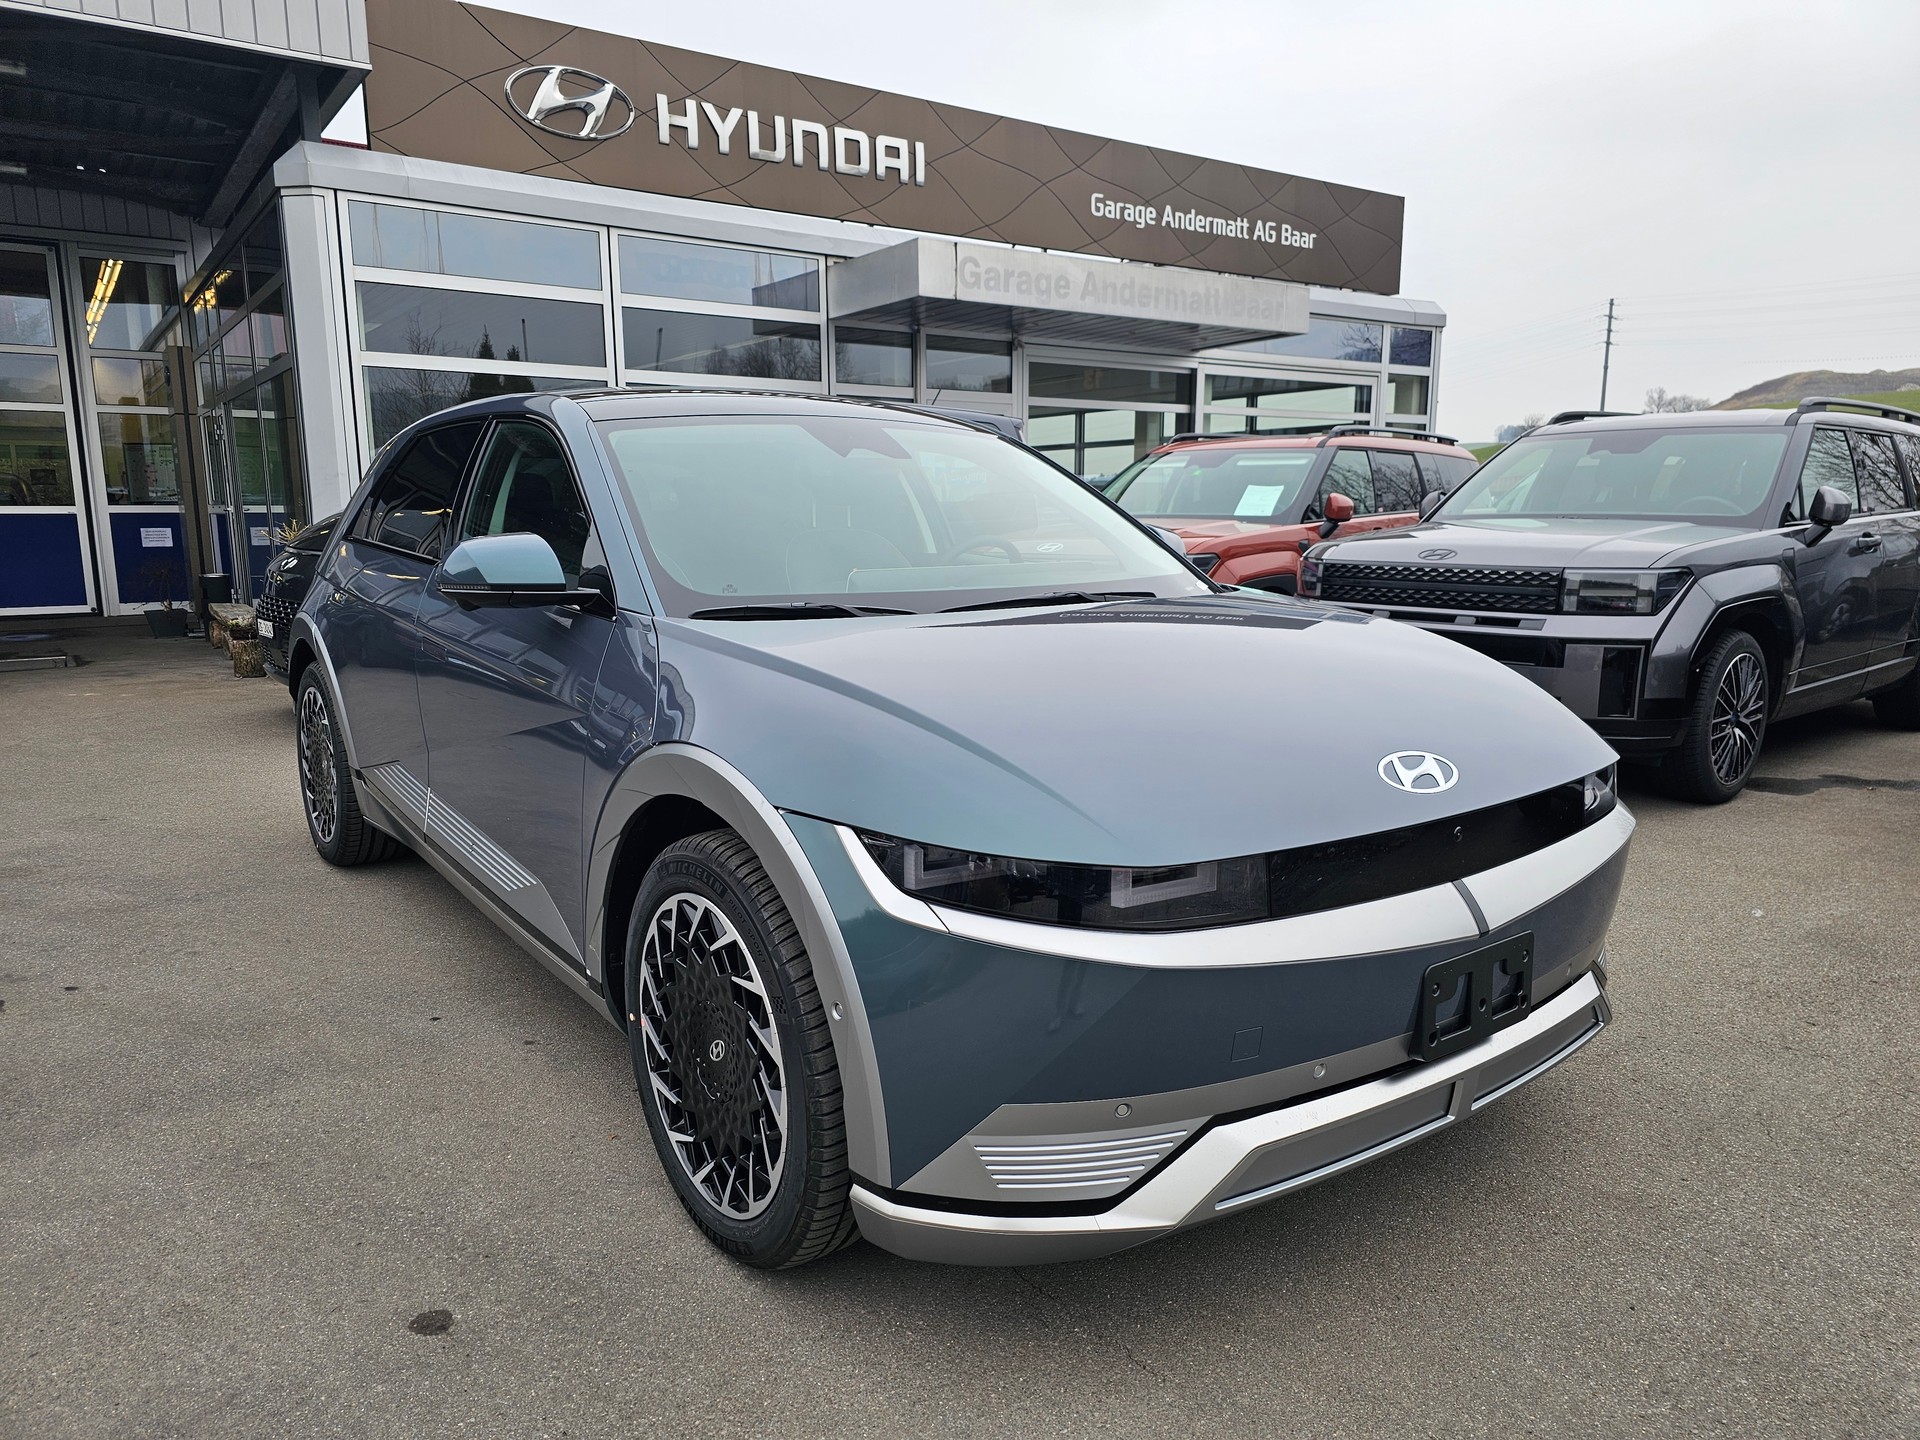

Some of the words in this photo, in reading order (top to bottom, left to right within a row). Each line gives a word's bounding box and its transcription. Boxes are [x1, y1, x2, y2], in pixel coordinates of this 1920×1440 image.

[656, 93, 926, 186] HYUNDAI
[1091, 193, 1156, 229] Garage
[1161, 205, 1249, 240] Andermatt
[1253, 220, 1277, 243] AG
[1281, 224, 1317, 249] Baar
[958, 255, 1071, 305] Garage
[1080, 270, 1221, 317] Andermatt
[668, 861, 724, 895] MICHELIN
[727, 898, 746, 924] PILOT
